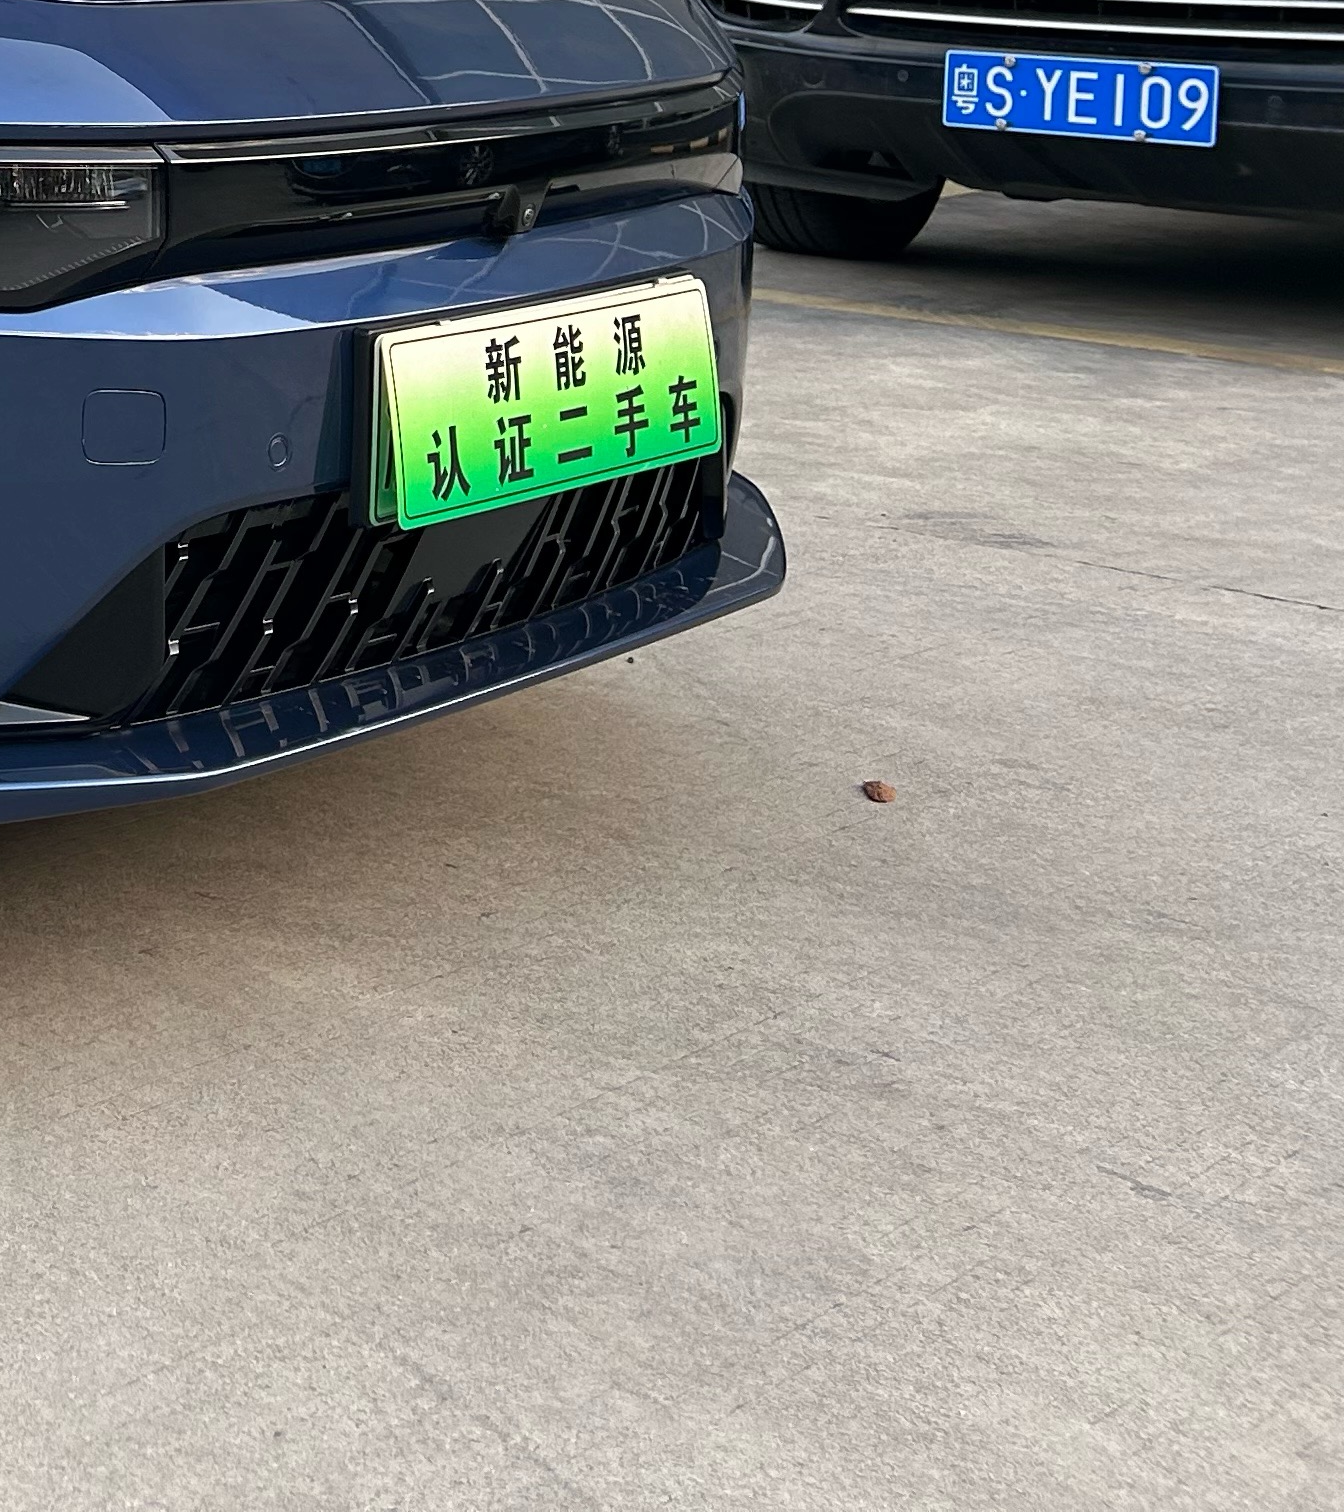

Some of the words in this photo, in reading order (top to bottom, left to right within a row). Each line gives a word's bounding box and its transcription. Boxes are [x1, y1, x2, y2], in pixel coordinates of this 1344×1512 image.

[485, 314, 646, 404] 新能源
[427, 375, 702, 502] 认证二手车
